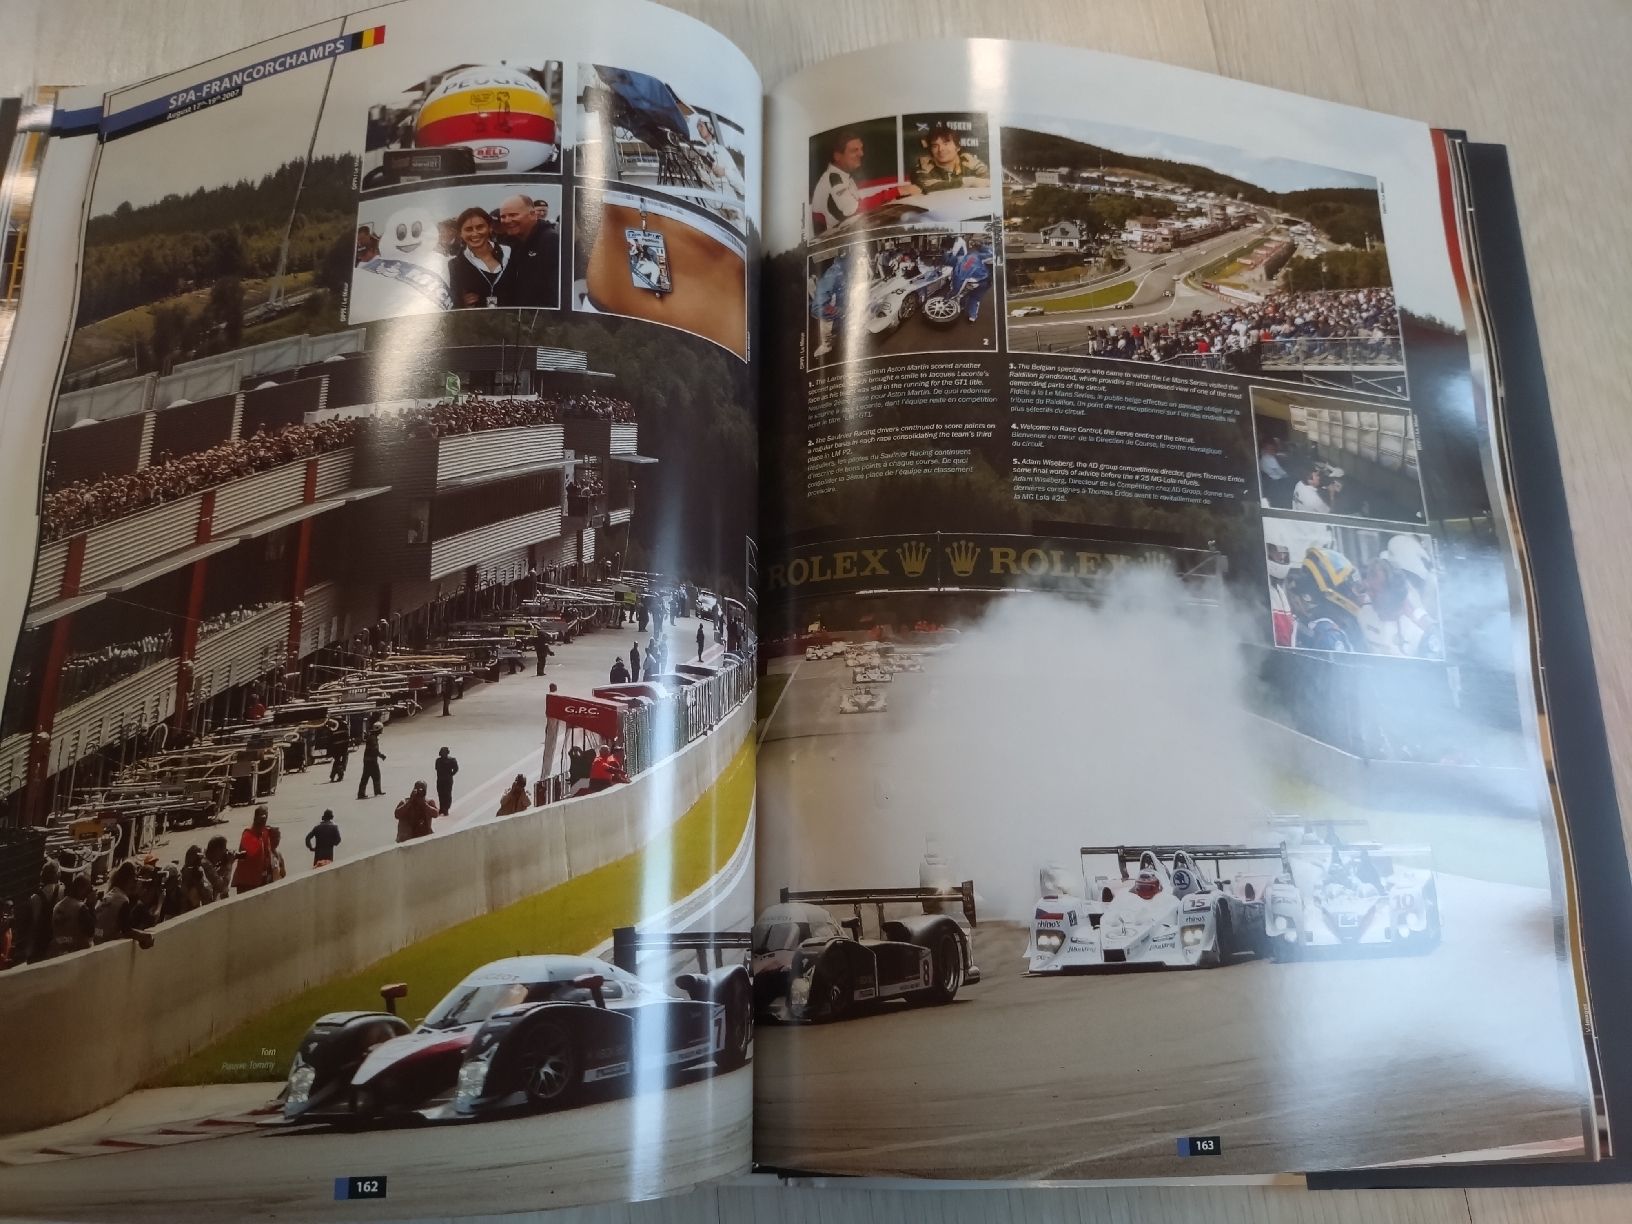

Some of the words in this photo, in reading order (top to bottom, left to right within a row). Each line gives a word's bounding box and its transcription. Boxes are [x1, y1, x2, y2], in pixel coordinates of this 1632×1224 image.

[168, 39, 345, 110] SPA-FRANCORCHAMPS
[166, 107, 192, 120] August
[222, 90, 240, 101] 2007
[477, 147, 506, 156] BELL
[1031, 364, 1056, 372] Belgian
[868, 375, 893, 384] brought
[1009, 380, 1046, 388] demanding
[1098, 377, 1124, 385] provides
[827, 432, 852, 442] Saulnier
[854, 428, 876, 438] Racing
[877, 426, 900, 434] drivers
[1078, 426, 1102, 435] Control,
[812, 444, 834, 453] regular
[893, 432, 938, 440] consolidating
[808, 454, 824, 464] place
[842, 448, 853, 456] P2.
[1042, 459, 1075, 468] Wiseberg,
[1119, 465, 1159, 474] competitions
[1160, 468, 1185, 477] director,
[1203, 472, 1226, 481] Thomas
[1177, 479, 1200, 487] refuels.
[990, 547, 1129, 578] ROLEX
[768, 548, 890, 590] ROLEX
[562, 704, 594, 714] G.P.C.
[1190, 898, 1206, 908] 15
[922, 959, 930, 986] 8
[713, 1017, 723, 1049] 7
[1196, 1140, 1214, 1151] 163
[356, 1181, 378, 1193] 162
